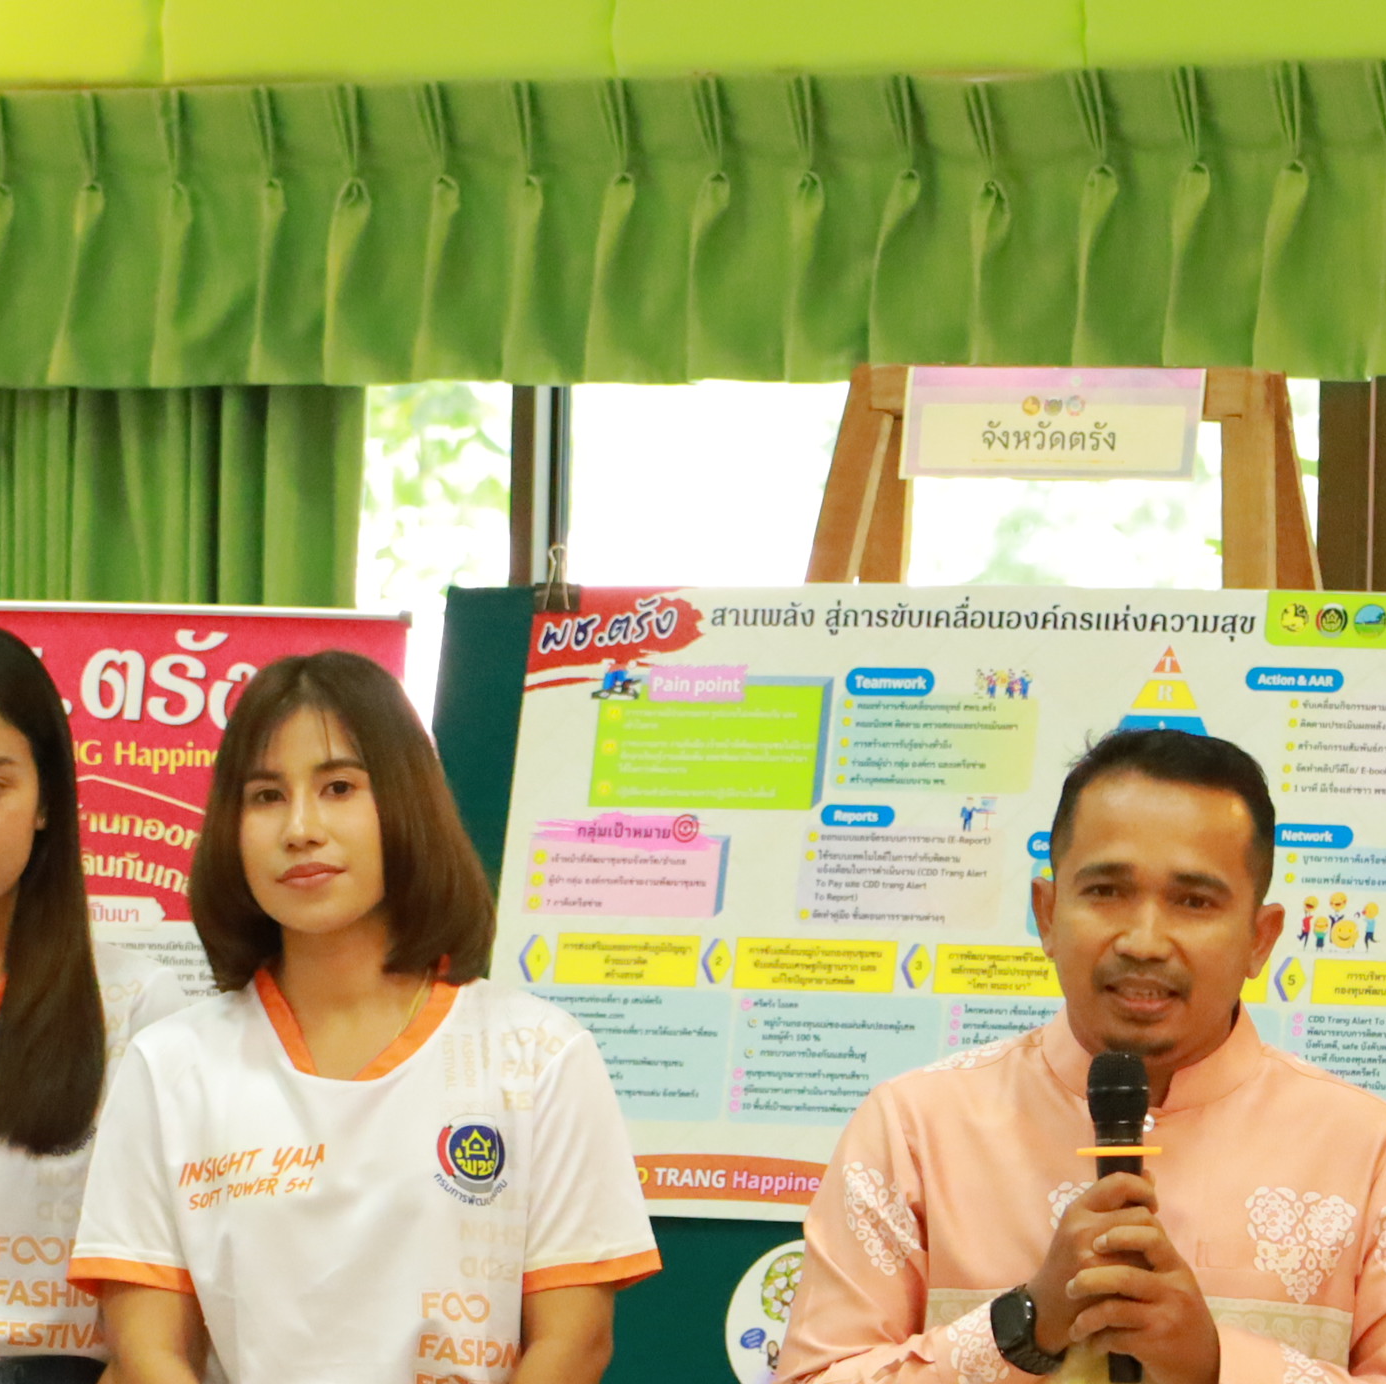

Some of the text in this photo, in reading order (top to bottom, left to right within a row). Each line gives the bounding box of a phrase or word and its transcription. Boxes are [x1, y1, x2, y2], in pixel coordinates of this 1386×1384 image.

[652, 677, 741, 697] Pain point
[855, 675, 927, 690] Teamwork
[1258, 673, 1334, 687] Action & AAR
[1157, 685, 1173, 701] R
[114, 740, 218, 775] Happin
[833, 809, 879, 824] Reports
[1282, 829, 1333, 843] Network
[814, 893, 825, 901] To
[1288, 975, 1296, 986] 5
[1308, 1015, 1325, 1024] CDD
[1328, 1016, 1350, 1027] Trang
[1352, 1017, 1372, 1026] Alert
[1375, 1018, 1385, 1026] To
[178, 1143, 326, 1188] INSIGHT YALA
[655, 1168, 821, 1195] TRANG Happine
[189, 1187, 222, 1211] SOFT
[226, 1176, 276, 1201] POWER
